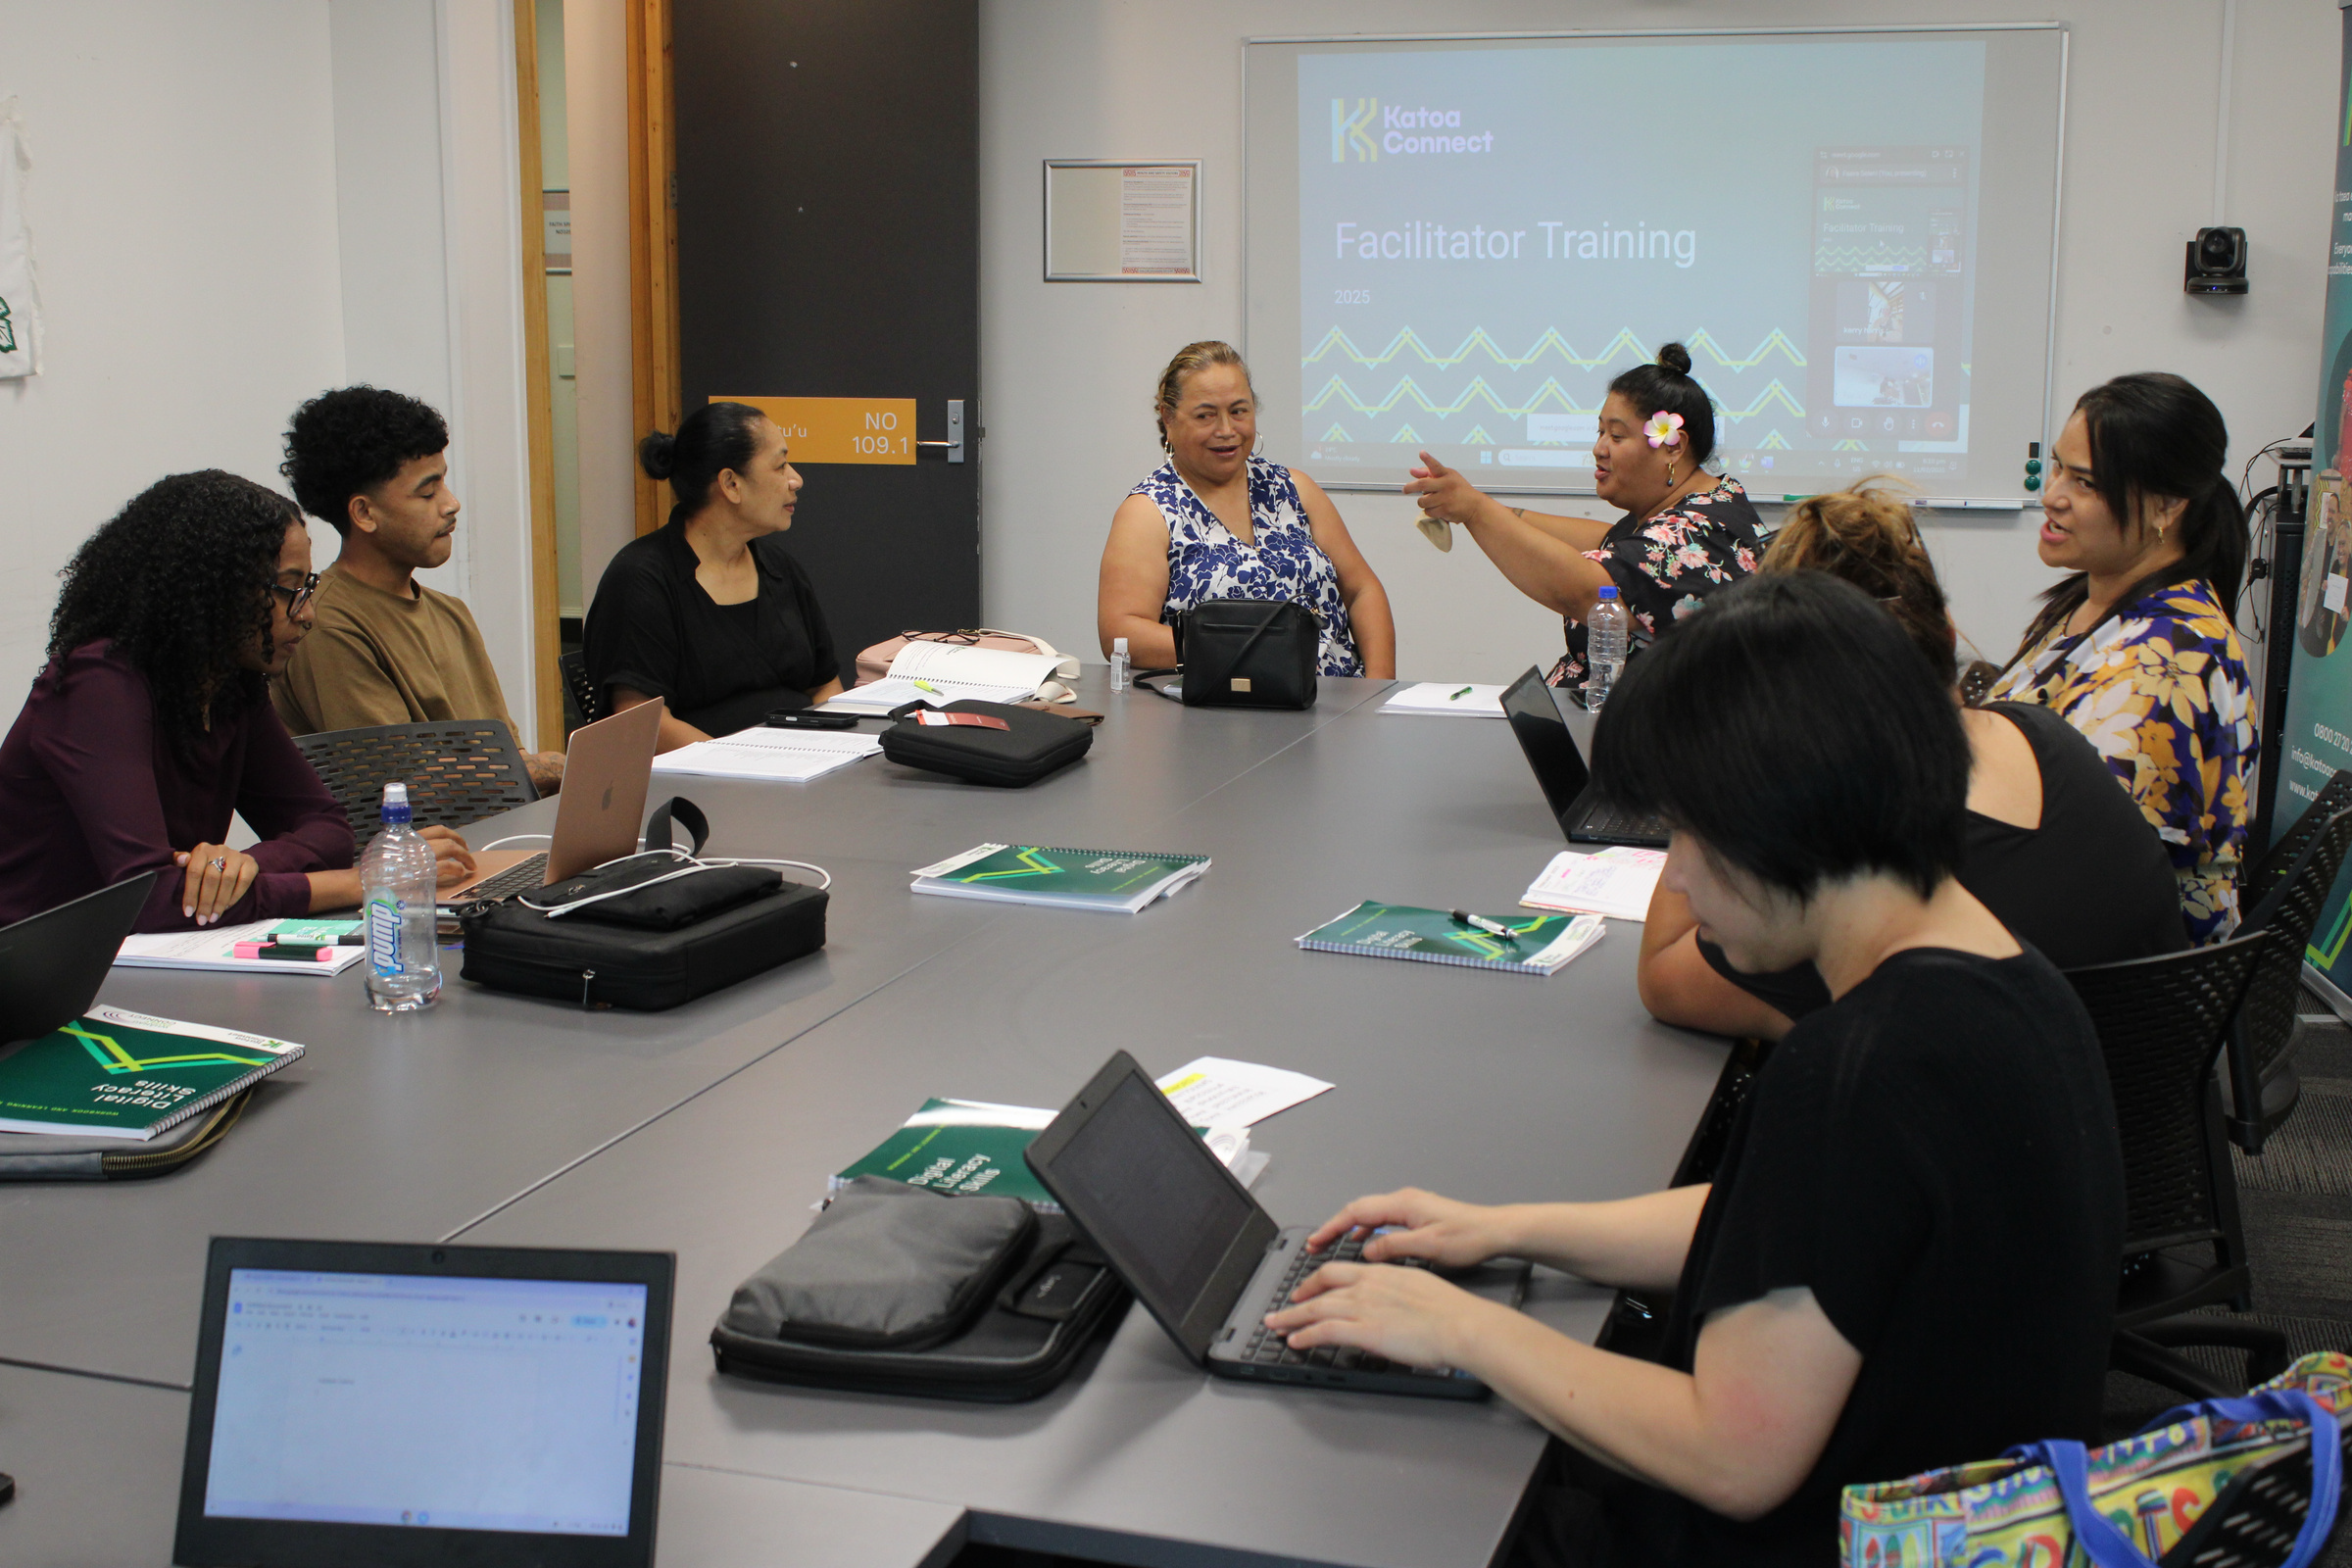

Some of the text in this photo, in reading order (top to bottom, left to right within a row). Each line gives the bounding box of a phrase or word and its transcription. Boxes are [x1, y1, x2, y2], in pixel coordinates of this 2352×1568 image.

[1383, 105, 1461, 128] Katoa
[1383, 130, 1494, 154] Connect
[1823, 222, 1904, 234] Facilitator Training
[1337, 220, 1696, 269] Facilitator Training
[1334, 289, 1370, 305] 2025
[865, 412, 897, 431] NO
[853, 436, 907, 455] 109.1
[2314, 722, 2333, 744] 0800
[370, 902, 403, 973] pump
[90, 1084, 185, 1102] Literacy
[134, 1080, 196, 1096] Skills
[7, 1102, 48, 1110] LEARNING
[93, 1094, 172, 1109] Digital
[906, 1156, 957, 1187] Digital
[932, 1152, 992, 1189] Literacy
[958, 1168, 1002, 1193] Skills
